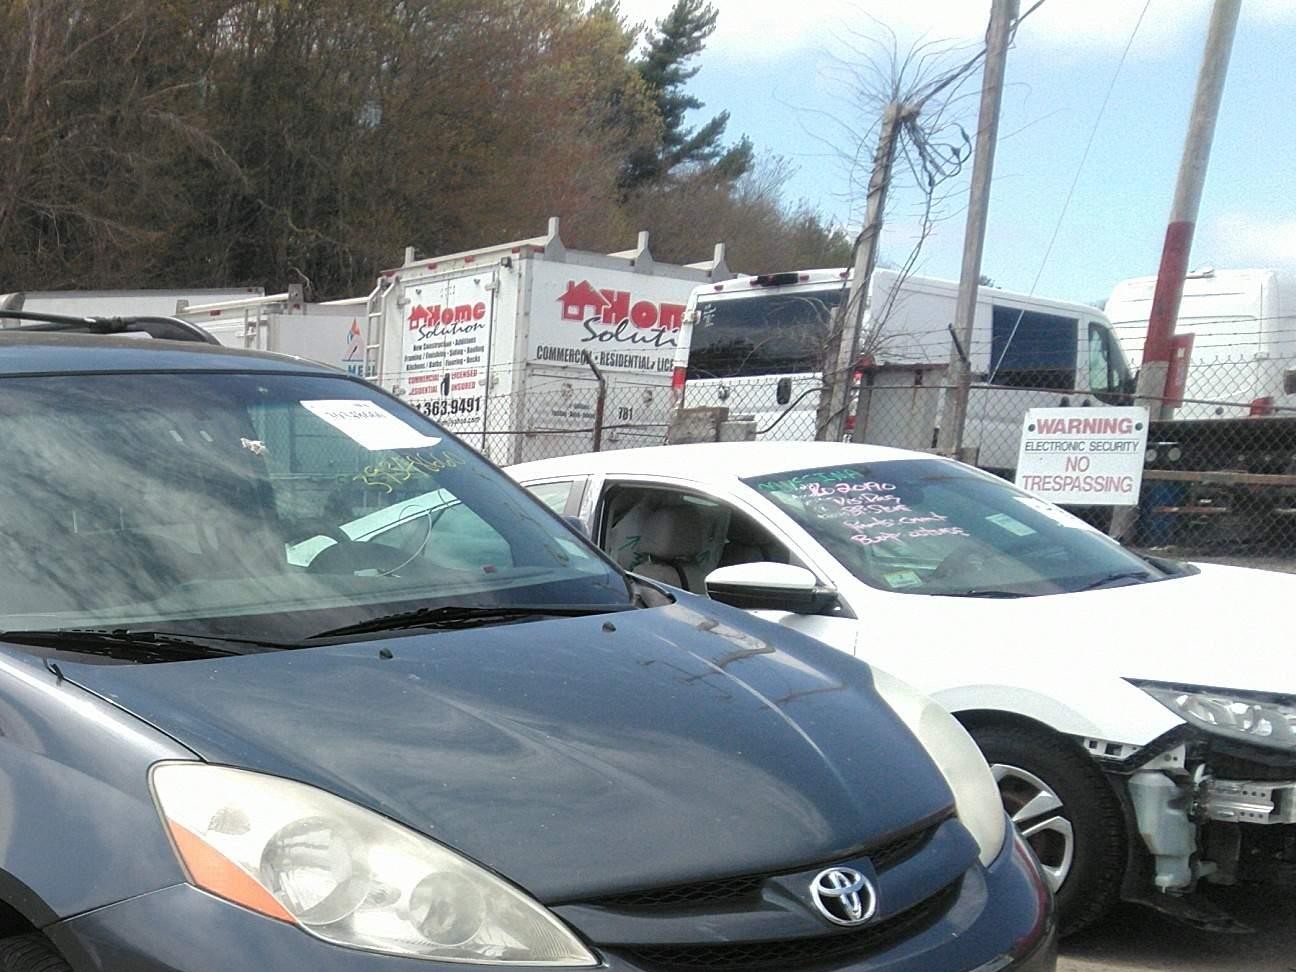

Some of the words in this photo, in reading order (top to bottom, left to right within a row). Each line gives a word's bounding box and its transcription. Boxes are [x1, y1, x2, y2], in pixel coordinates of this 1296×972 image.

[426, 302, 486, 328] Home
[417, 320, 485, 341] Solution
[600, 351, 651, 371] RESIDENTIAL
[1036, 417, 1134, 435] WARNING
[1025, 441, 1086, 452] ELECTRONIC
[1089, 441, 1140, 452] SECURITY
[1065, 455, 1090, 473] NO
[1022, 475, 1134, 493] TRESPASSING
